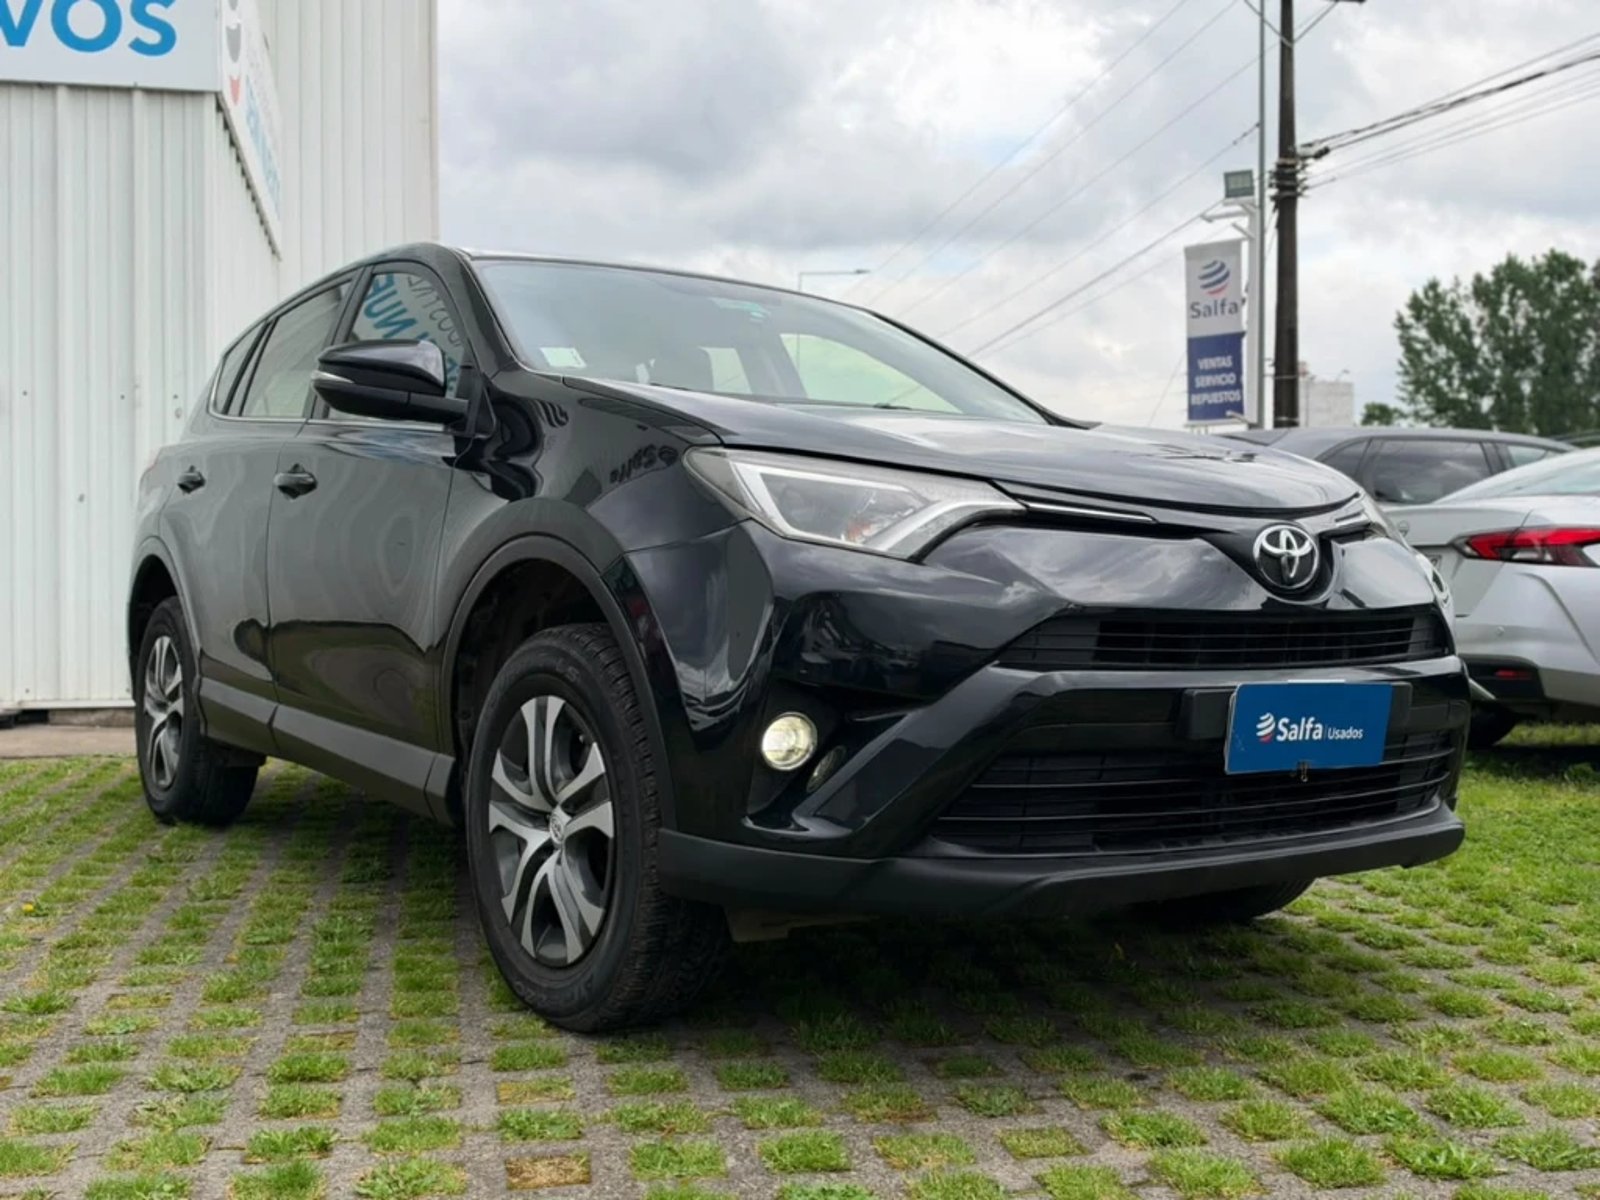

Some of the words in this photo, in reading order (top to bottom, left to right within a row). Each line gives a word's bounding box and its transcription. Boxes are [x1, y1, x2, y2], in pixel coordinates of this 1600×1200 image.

[0, 0, 177, 57] VOS
[1190, 297, 1239, 319] Salfa
[1197, 355, 1233, 370] VENTAS
[1194, 372, 1237, 389] SERVICIO
[1191, 389, 1241, 405] REPUESTOS
[1276, 716, 1323, 741] Salfa
[1327, 726, 1363, 741] Usados
